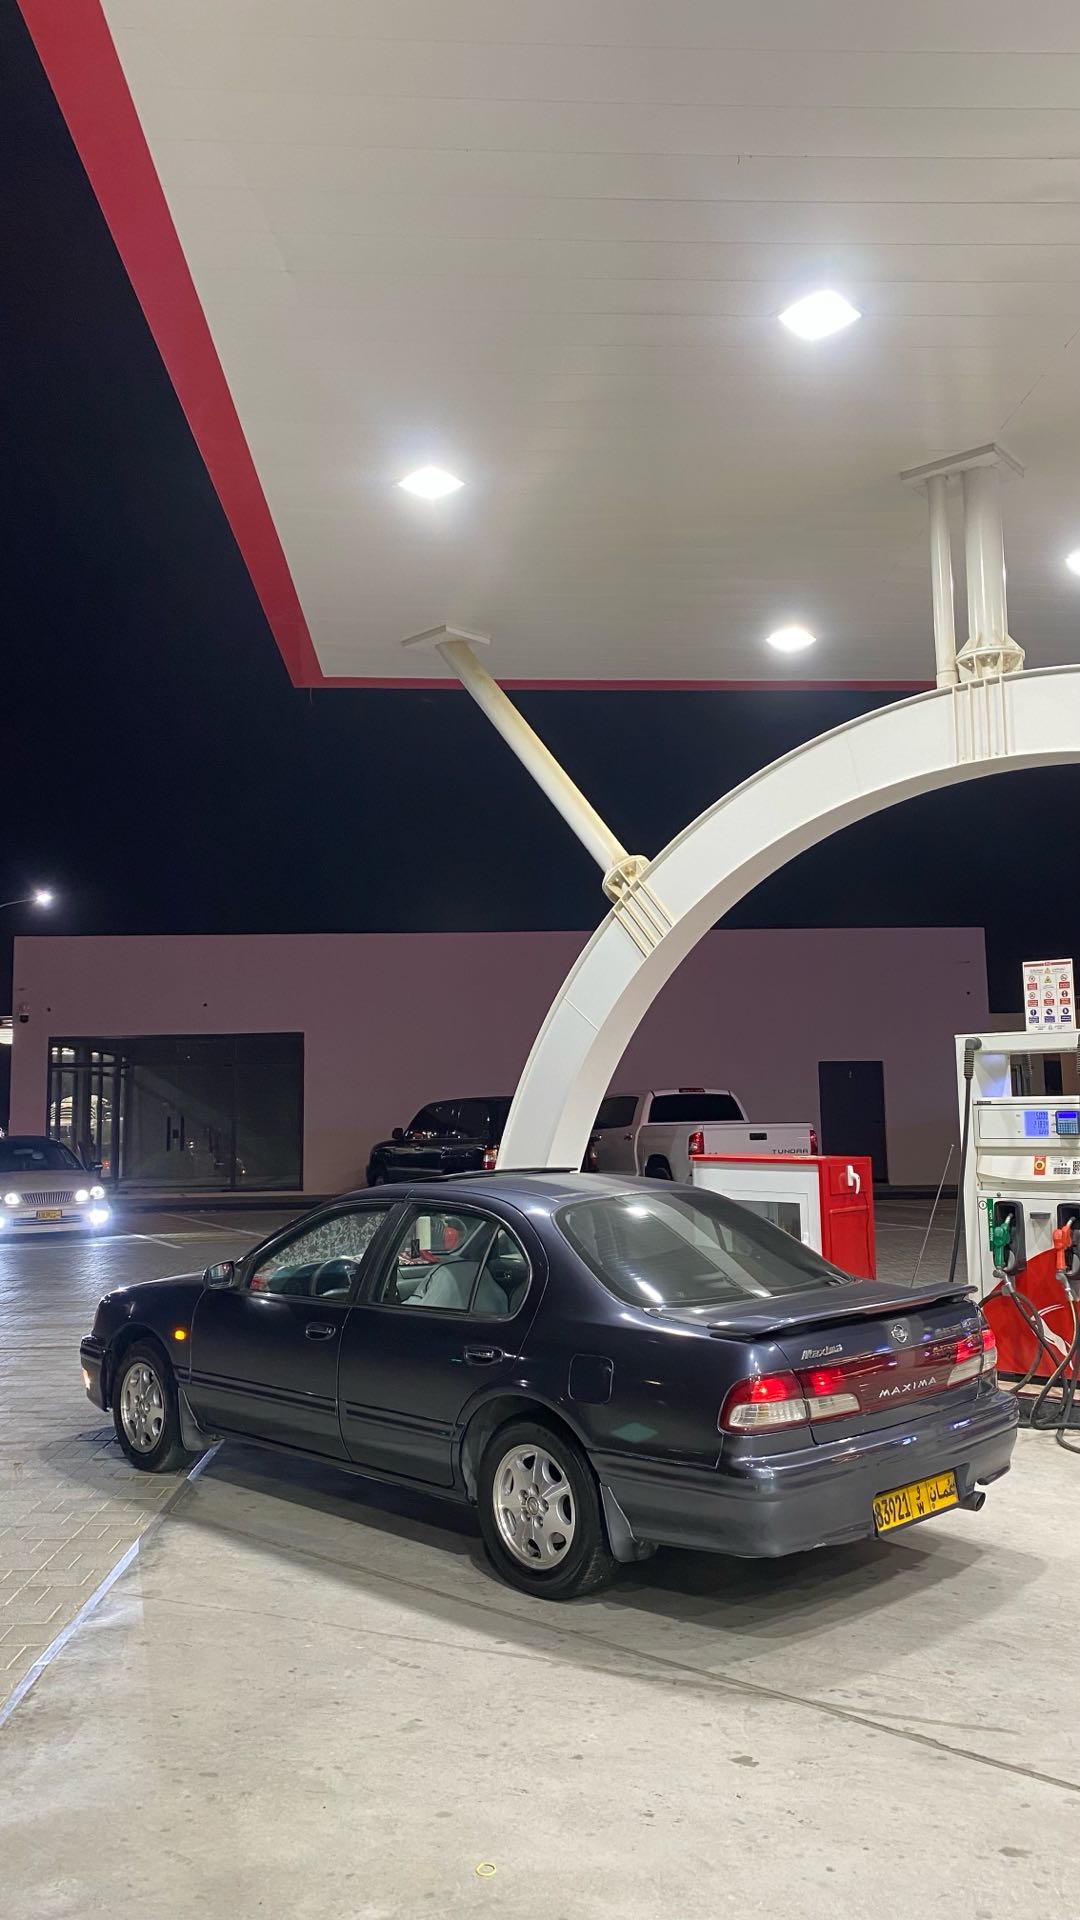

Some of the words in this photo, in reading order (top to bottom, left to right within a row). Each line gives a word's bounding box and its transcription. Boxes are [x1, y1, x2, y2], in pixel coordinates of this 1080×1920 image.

[800, 1343, 843, 1361] Maxima
[878, 1376, 937, 1399] MAXIMA
[874, 1492, 911, 1528] 83921
[916, 1501, 925, 1515] W
